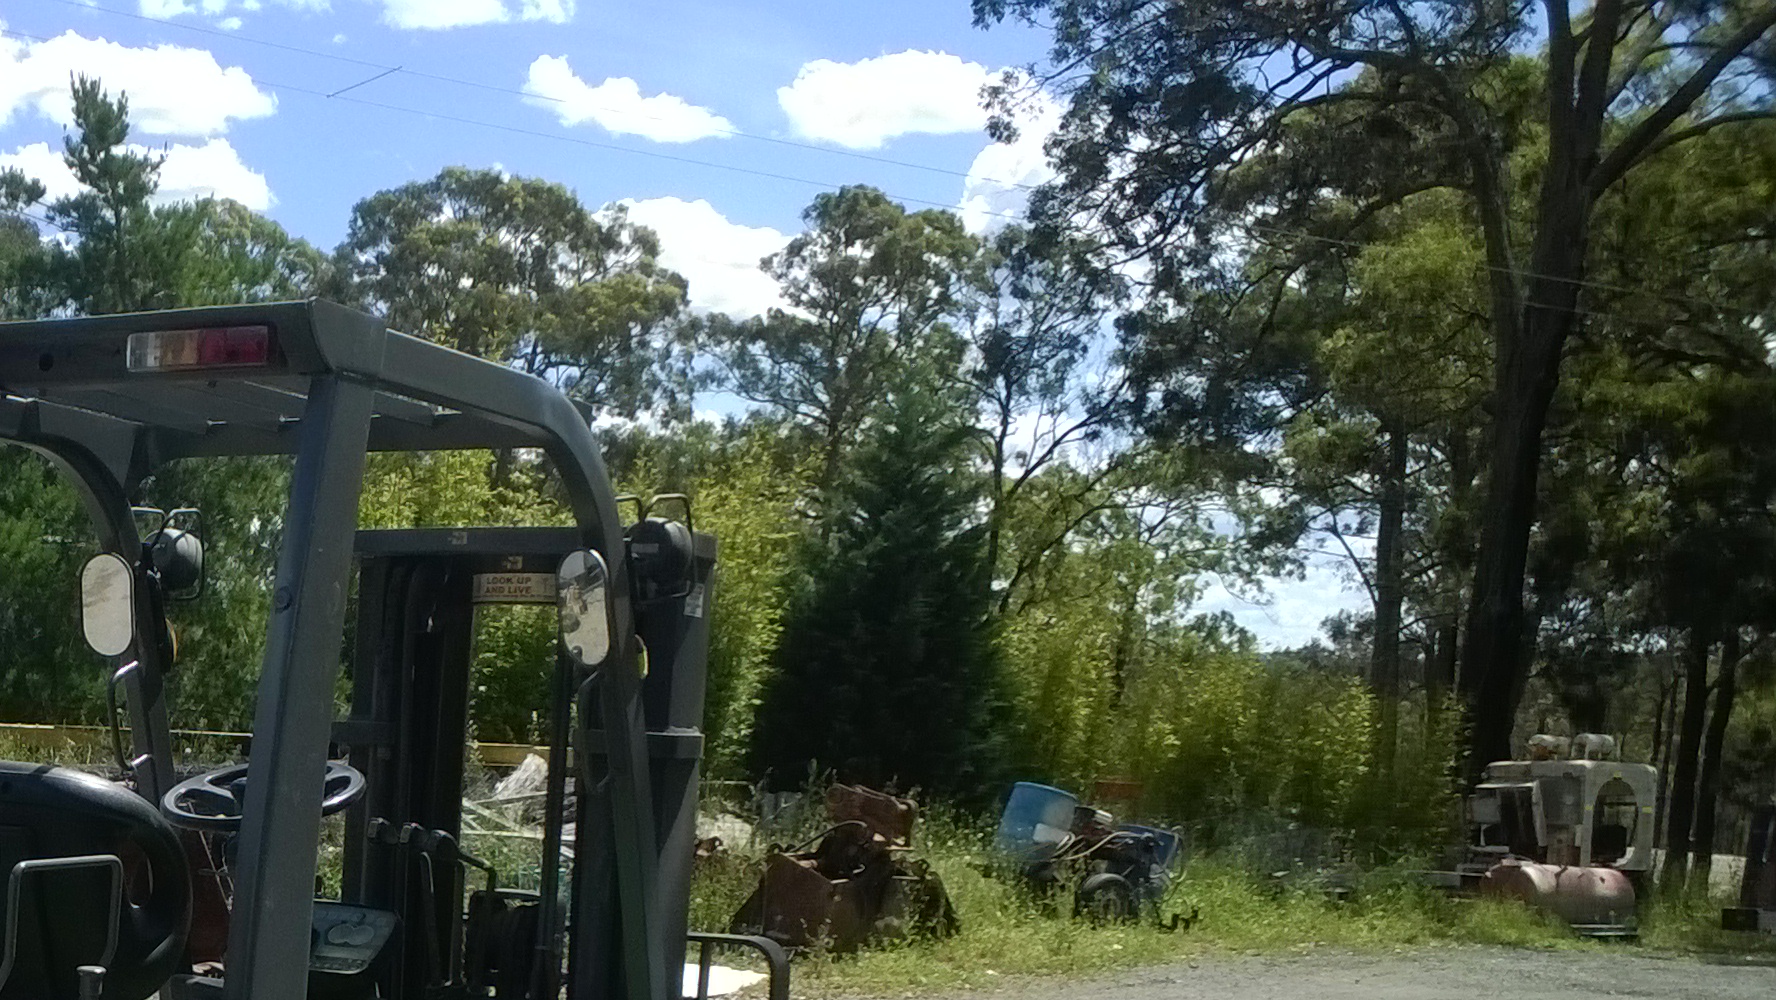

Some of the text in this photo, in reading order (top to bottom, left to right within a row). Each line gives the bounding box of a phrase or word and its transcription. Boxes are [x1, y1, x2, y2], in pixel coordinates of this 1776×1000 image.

[486, 576, 532, 585] LOOK UP
[485, 586, 532, 594] AND LIVE
